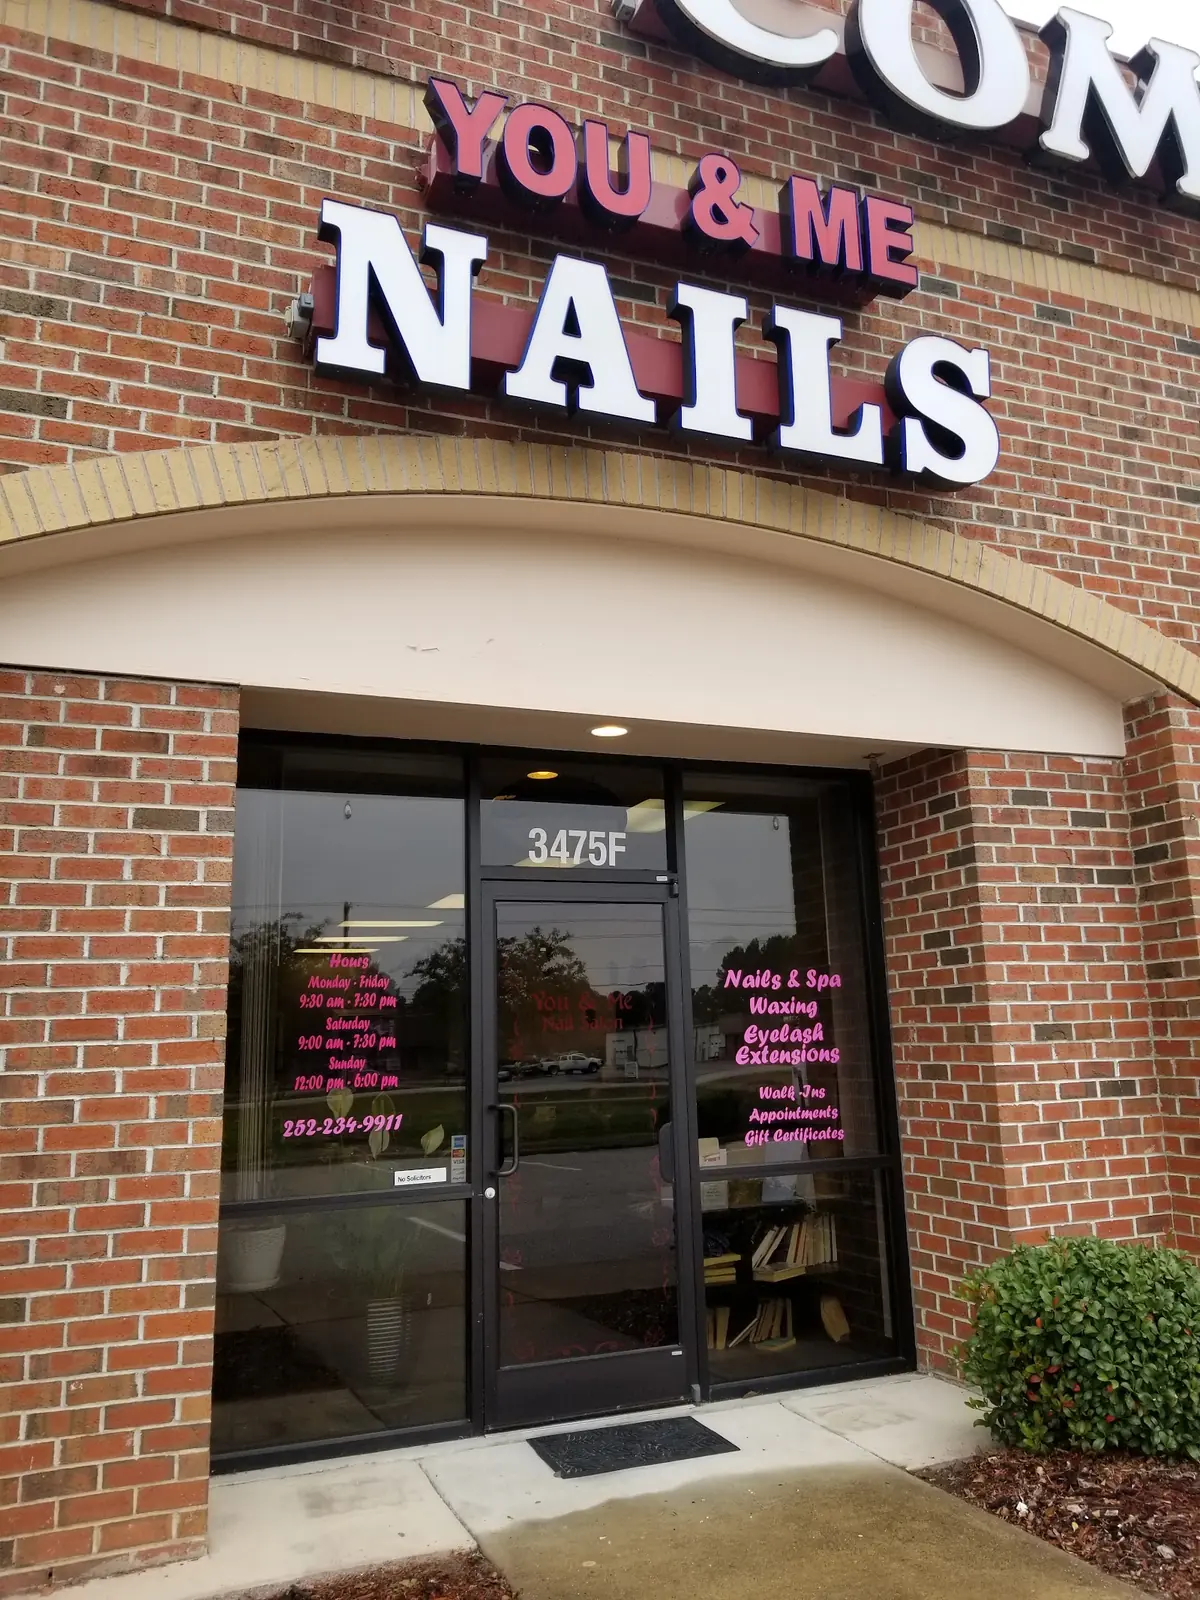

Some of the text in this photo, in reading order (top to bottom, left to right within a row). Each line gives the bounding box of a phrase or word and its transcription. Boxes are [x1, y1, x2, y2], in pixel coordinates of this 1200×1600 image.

[426, 78, 918, 286] YOU & ME
[316, 198, 1000, 485] NAILS
[527, 827, 627, 867] 3475F
[329, 953, 369, 969] Hours
[308, 975, 351, 991] Monday
[360, 974, 389, 990] Friday
[723, 969, 842, 991] Nails & Spa
[300, 993, 324, 1009] 9:30
[326, 996, 345, 1009] am
[354, 992, 377, 1008] 7:30
[379, 995, 397, 1010] pm
[749, 996, 818, 1019] Waxing
[325, 1016, 371, 1031] Saturday
[298, 1035, 323, 1050] 9:00
[325, 1038, 344, 1050] am
[353, 1034, 376, 1049] 7:30
[379, 1036, 397, 1051] pm
[744, 1022, 824, 1047] Eyelash
[328, 1055, 366, 1071] Sunday
[735, 1043, 840, 1065] Extensions
[294, 1075, 323, 1090] 12:00
[326, 1077, 345, 1092] pm
[353, 1073, 378, 1088] 6:00
[381, 1075, 399, 1090] pm
[749, 1107, 839, 1124] Appointments
[283, 1114, 403, 1137] 252-234-9911
[744, 1128, 845, 1147] Gift Certificates
[406, 1174, 432, 1182] Solicitors
